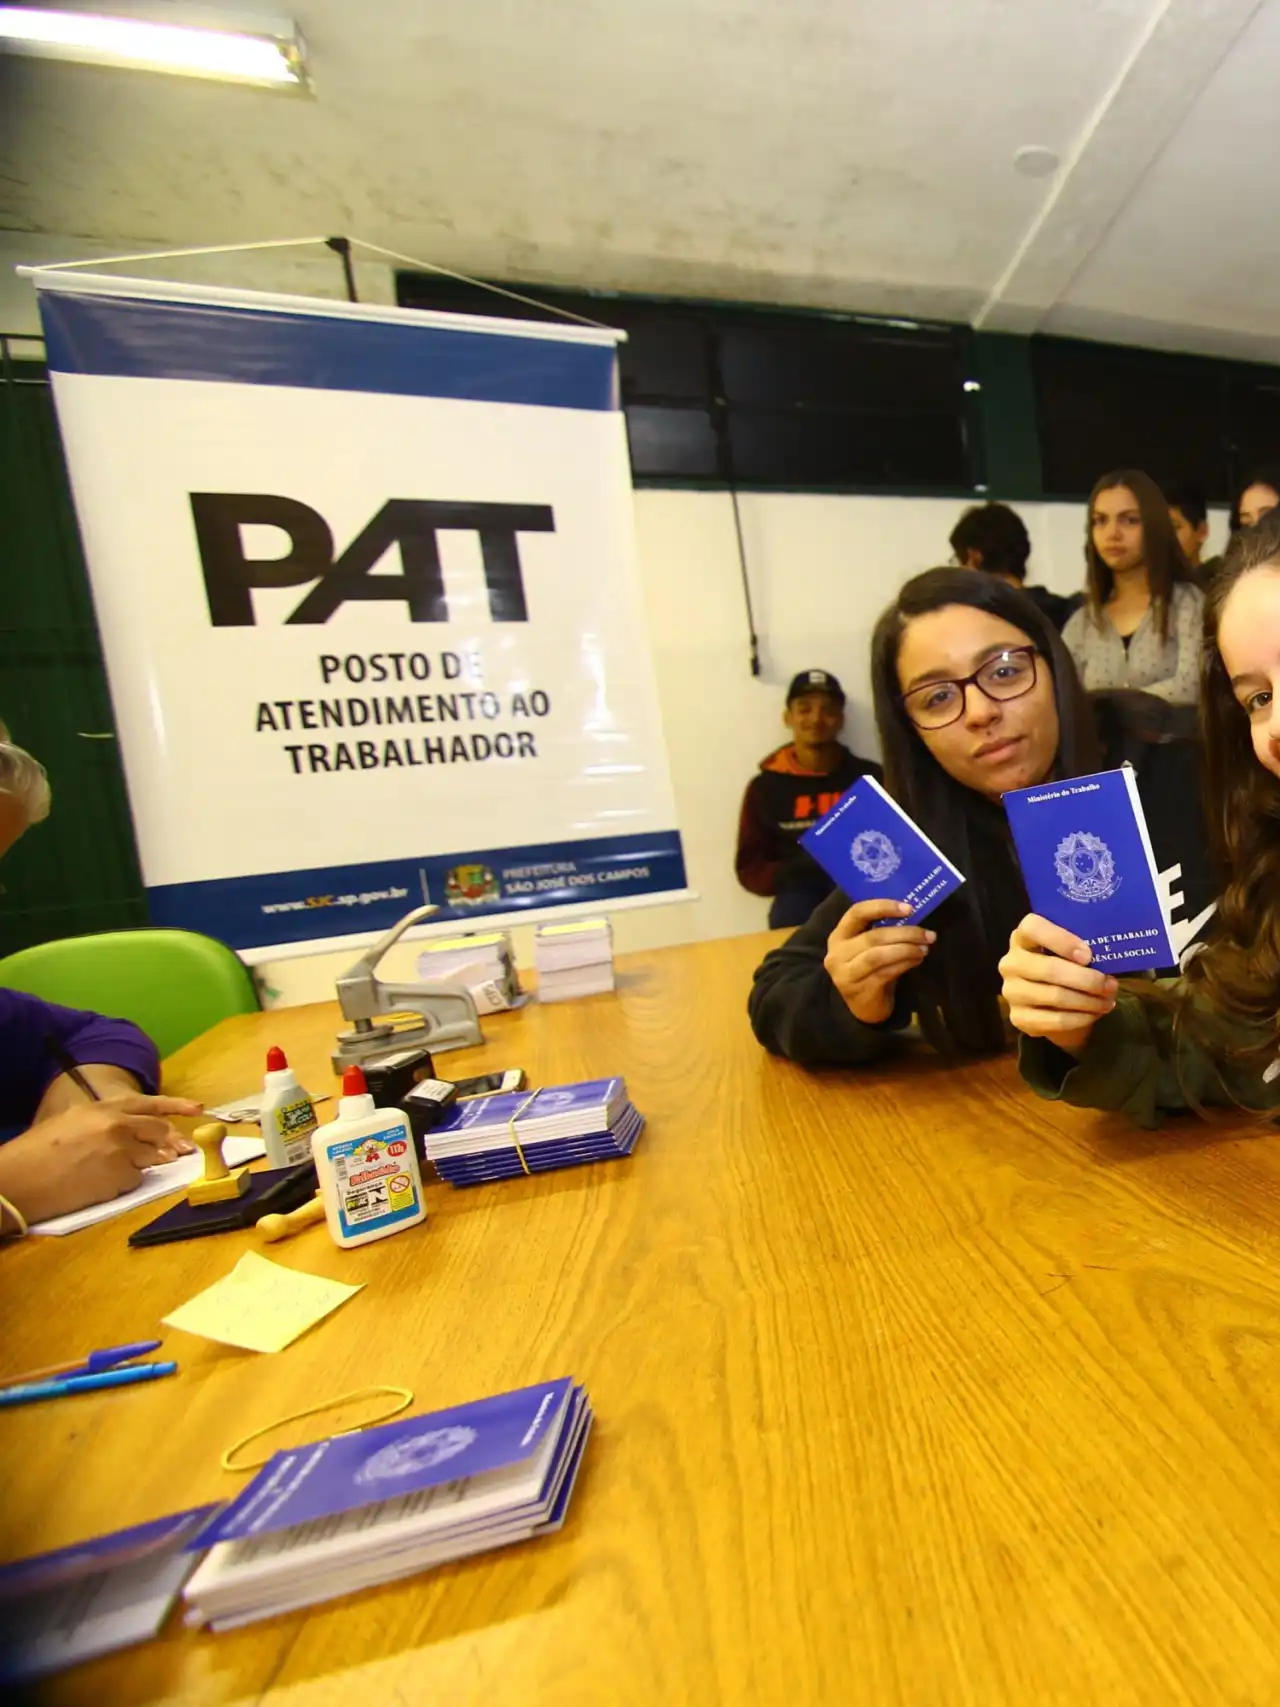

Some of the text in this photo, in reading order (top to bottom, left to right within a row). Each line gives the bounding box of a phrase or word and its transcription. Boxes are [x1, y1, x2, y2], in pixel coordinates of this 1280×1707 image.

[188, 491, 556, 627] PAT
[320, 649, 484, 684] POSTO DE
[255, 689, 552, 733] ATENDIMENTO AO
[284, 731, 538, 775] TRABALHADOR
[1027, 783, 1100, 804] Ministério do Trabalho
[502, 860, 577, 879] PREFEITURA
[505, 865, 651, 895] SÃO JOSÉ DOS CAMPOS
[1097, 935, 1110, 944] DE
[1111, 928, 1159, 943] TRABALHO
[1104, 944, 1112, 952] E
[1123, 947, 1157, 959] SOCIAL
